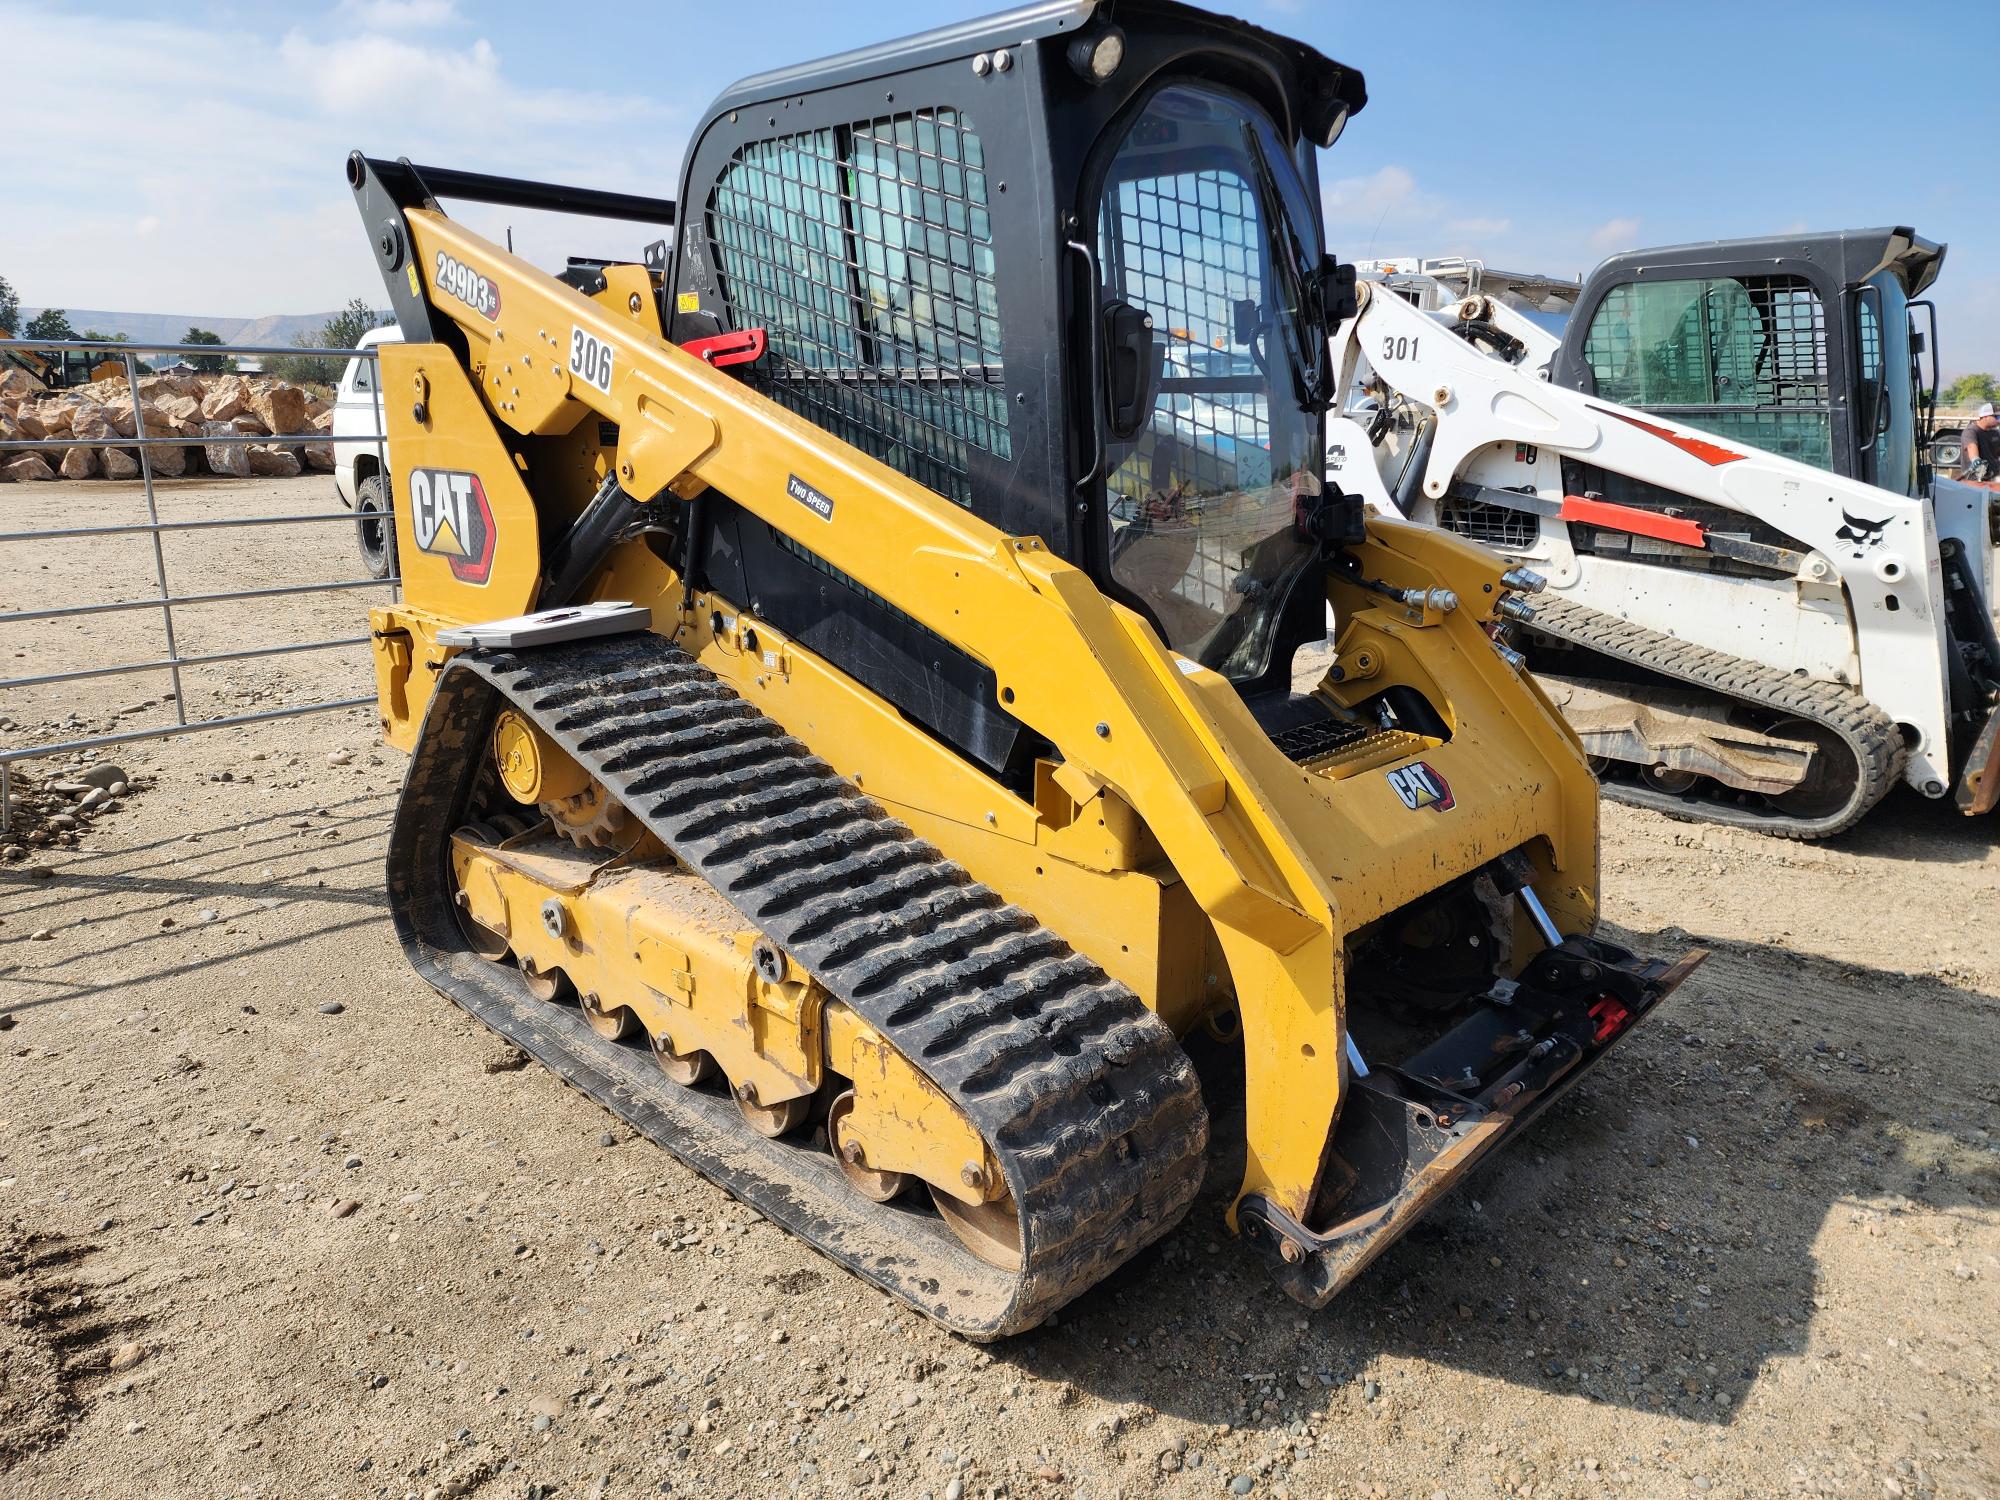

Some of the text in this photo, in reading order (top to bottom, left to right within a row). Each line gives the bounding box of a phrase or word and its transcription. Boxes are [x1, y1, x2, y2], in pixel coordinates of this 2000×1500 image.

[436, 252, 489, 313] 299D3
[571, 329, 611, 395] 306
[1383, 336, 1419, 361] 301
[410, 470, 472, 556] CAT
[790, 479, 830, 514] TWO SPEED
[1387, 763, 1441, 809] CAT
